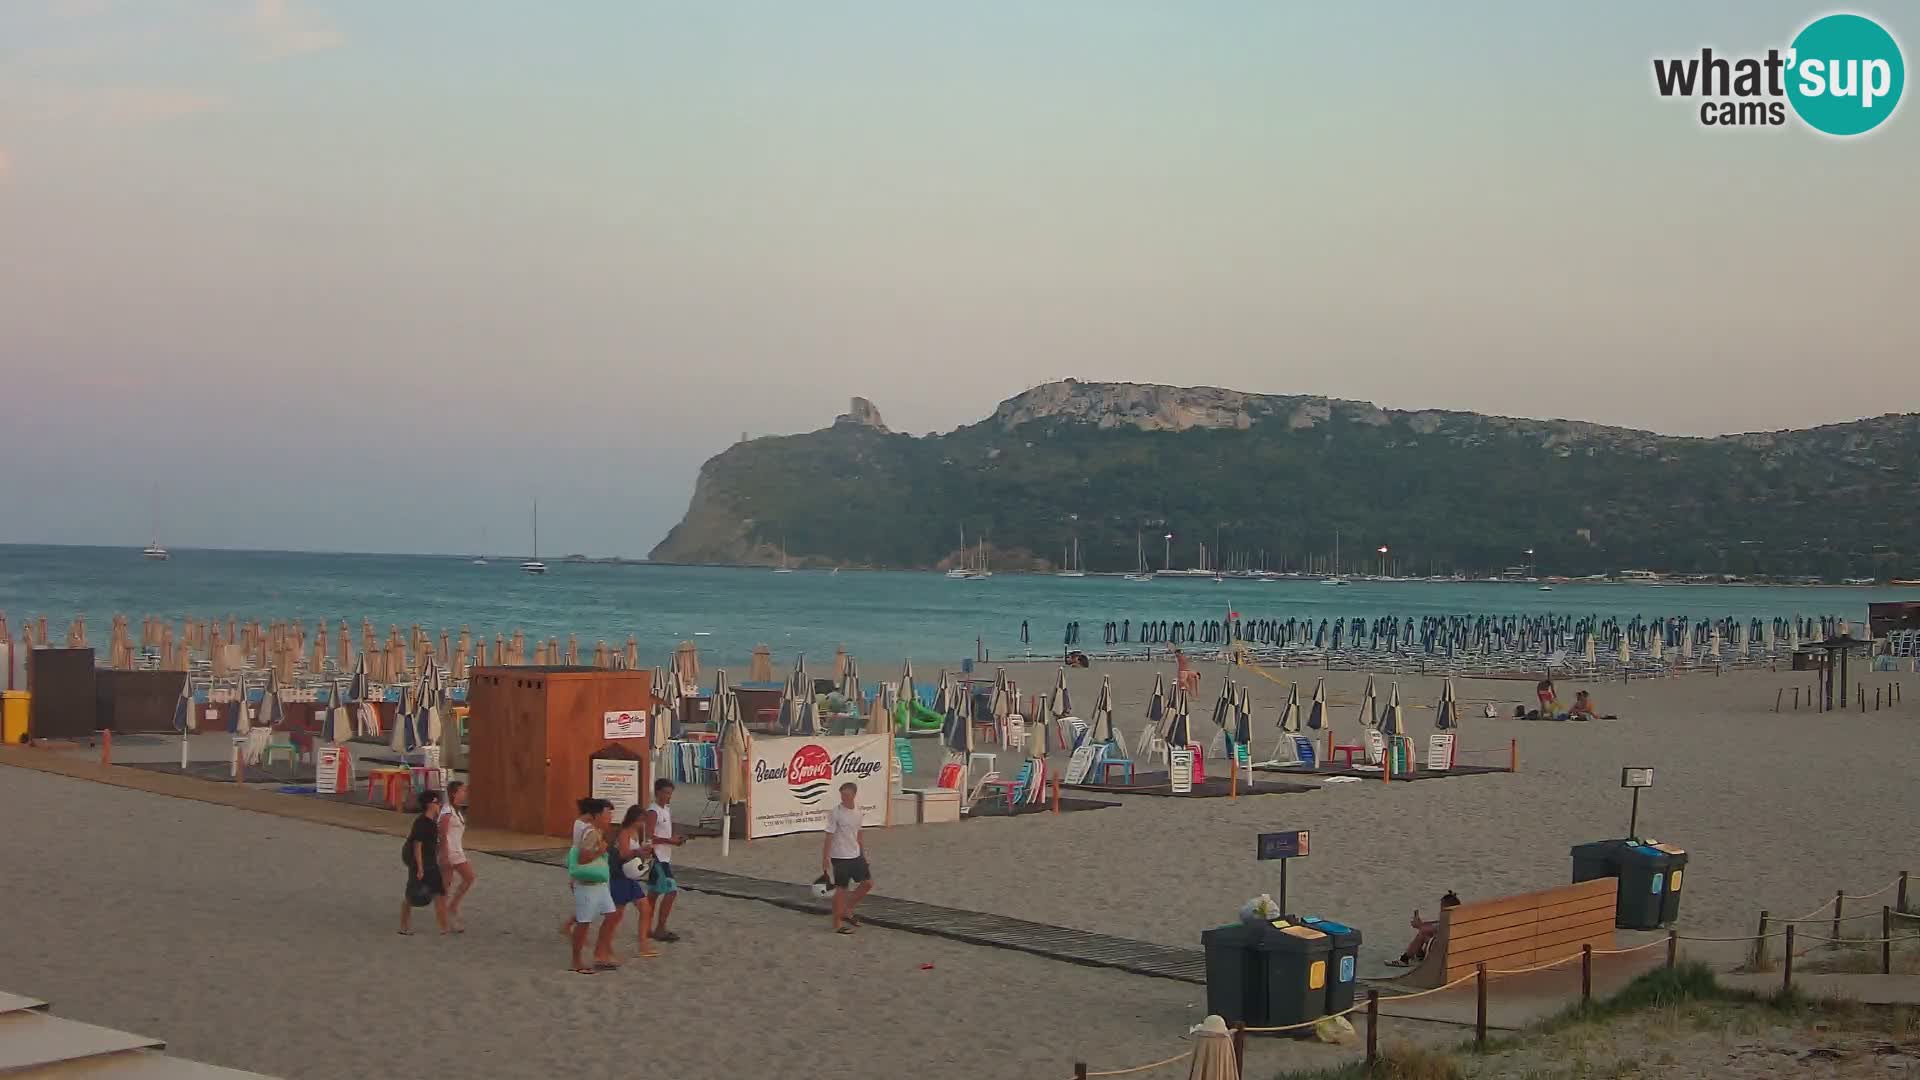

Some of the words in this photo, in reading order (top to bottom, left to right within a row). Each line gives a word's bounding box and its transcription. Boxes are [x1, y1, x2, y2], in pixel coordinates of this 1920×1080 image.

[755, 759, 788, 782] Beach
[790, 755, 830, 782] Sport
[831, 750, 881, 778] Village
